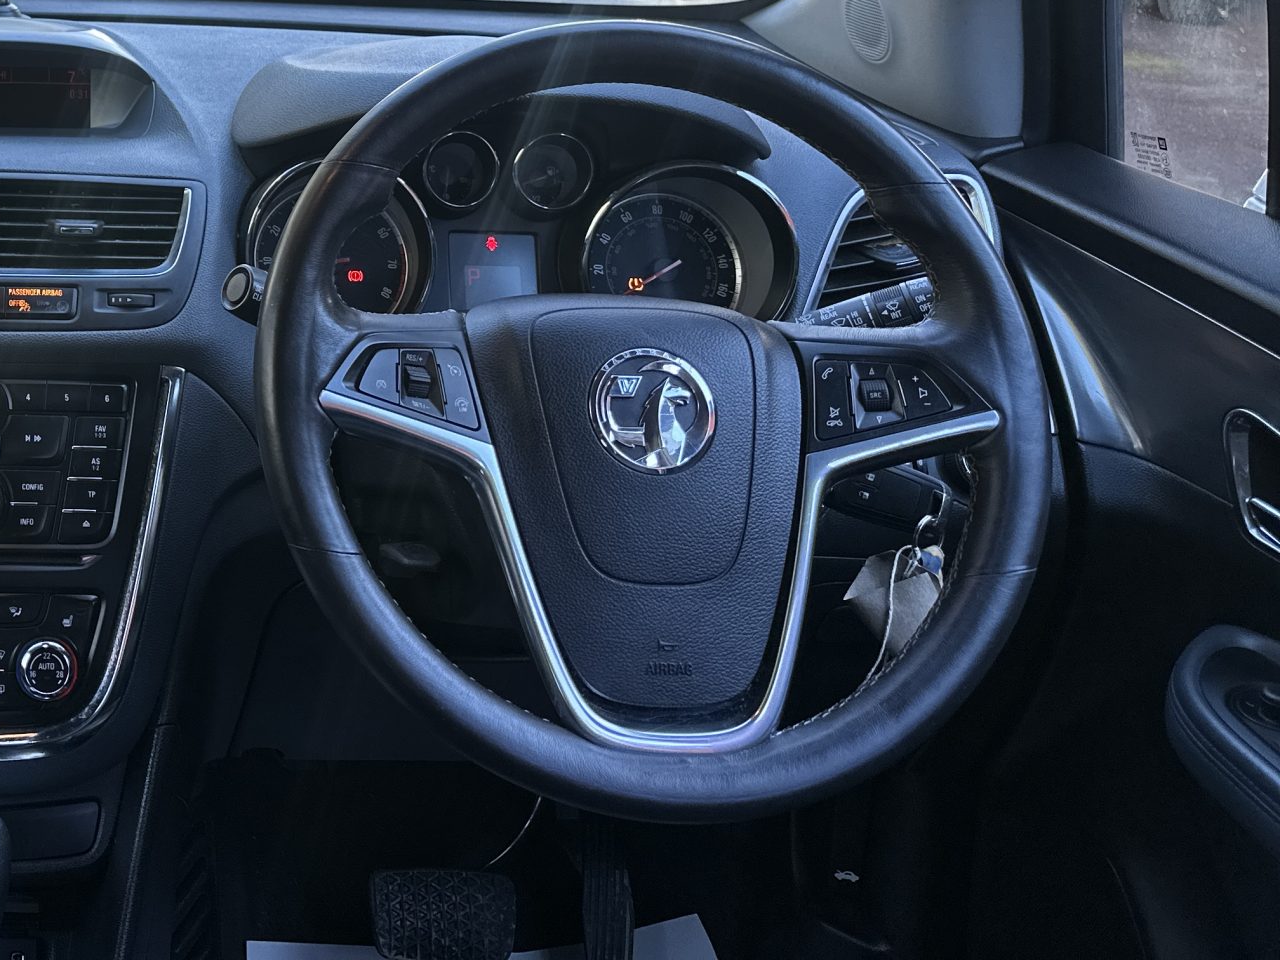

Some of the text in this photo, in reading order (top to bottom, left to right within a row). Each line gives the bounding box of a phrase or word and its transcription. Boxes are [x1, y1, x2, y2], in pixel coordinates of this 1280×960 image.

[651, 204, 663, 215] 80
[620, 211, 633, 223] 60
[679, 209, 694, 224] 100
[599, 232, 612, 245] 40
[701, 227, 717, 244] 120
[717, 253, 729, 269] 140
[593, 264, 604, 275] 20
[8, 288, 64, 297] PASSENGER AIRBAG
[716, 282, 728, 297] 160
[8, 299, 20, 307] OFF
[914, 295, 926, 304] ON
[820, 312, 838, 322] REAR
[890, 310, 903, 320] INT
[25, 393, 31, 401] 4
[64, 393, 70, 402] 5
[104, 395, 110, 403] 6
[94, 424, 107, 433] FAV
[91, 457, 101, 465] AS
[21, 483, 44, 491] CONFIG
[88, 490, 96, 498] TP
[19, 518, 34, 526] INFO
[42, 652, 51, 660] 22
[38, 663, 55, 671] AUTO
[646, 662, 693, 677] AIRBAG
[29, 670, 37, 679] 16
[55, 670, 64, 679] 28
